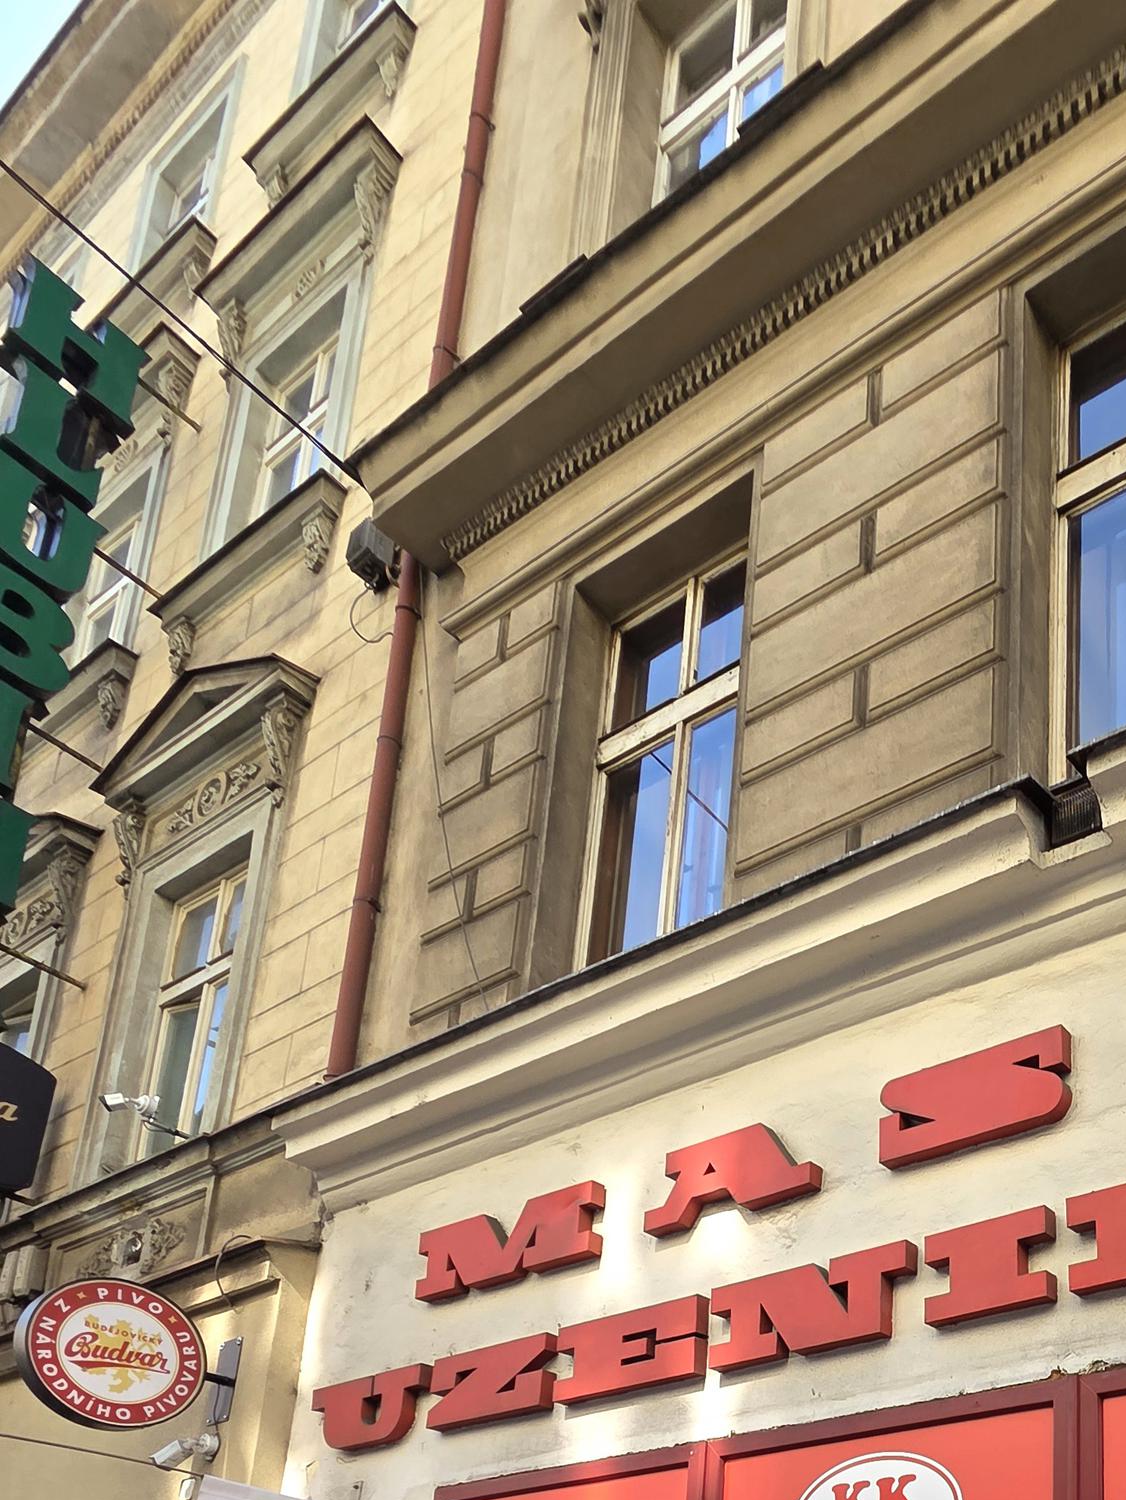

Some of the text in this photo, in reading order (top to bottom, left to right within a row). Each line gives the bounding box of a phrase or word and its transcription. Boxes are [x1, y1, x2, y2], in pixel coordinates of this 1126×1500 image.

[97, 1287, 163, 1315] PIVO
[36, 1298, 197, 1420] Z NÁRODNÍHO PIVOVARU
[64, 1331, 170, 1374] Budvar
